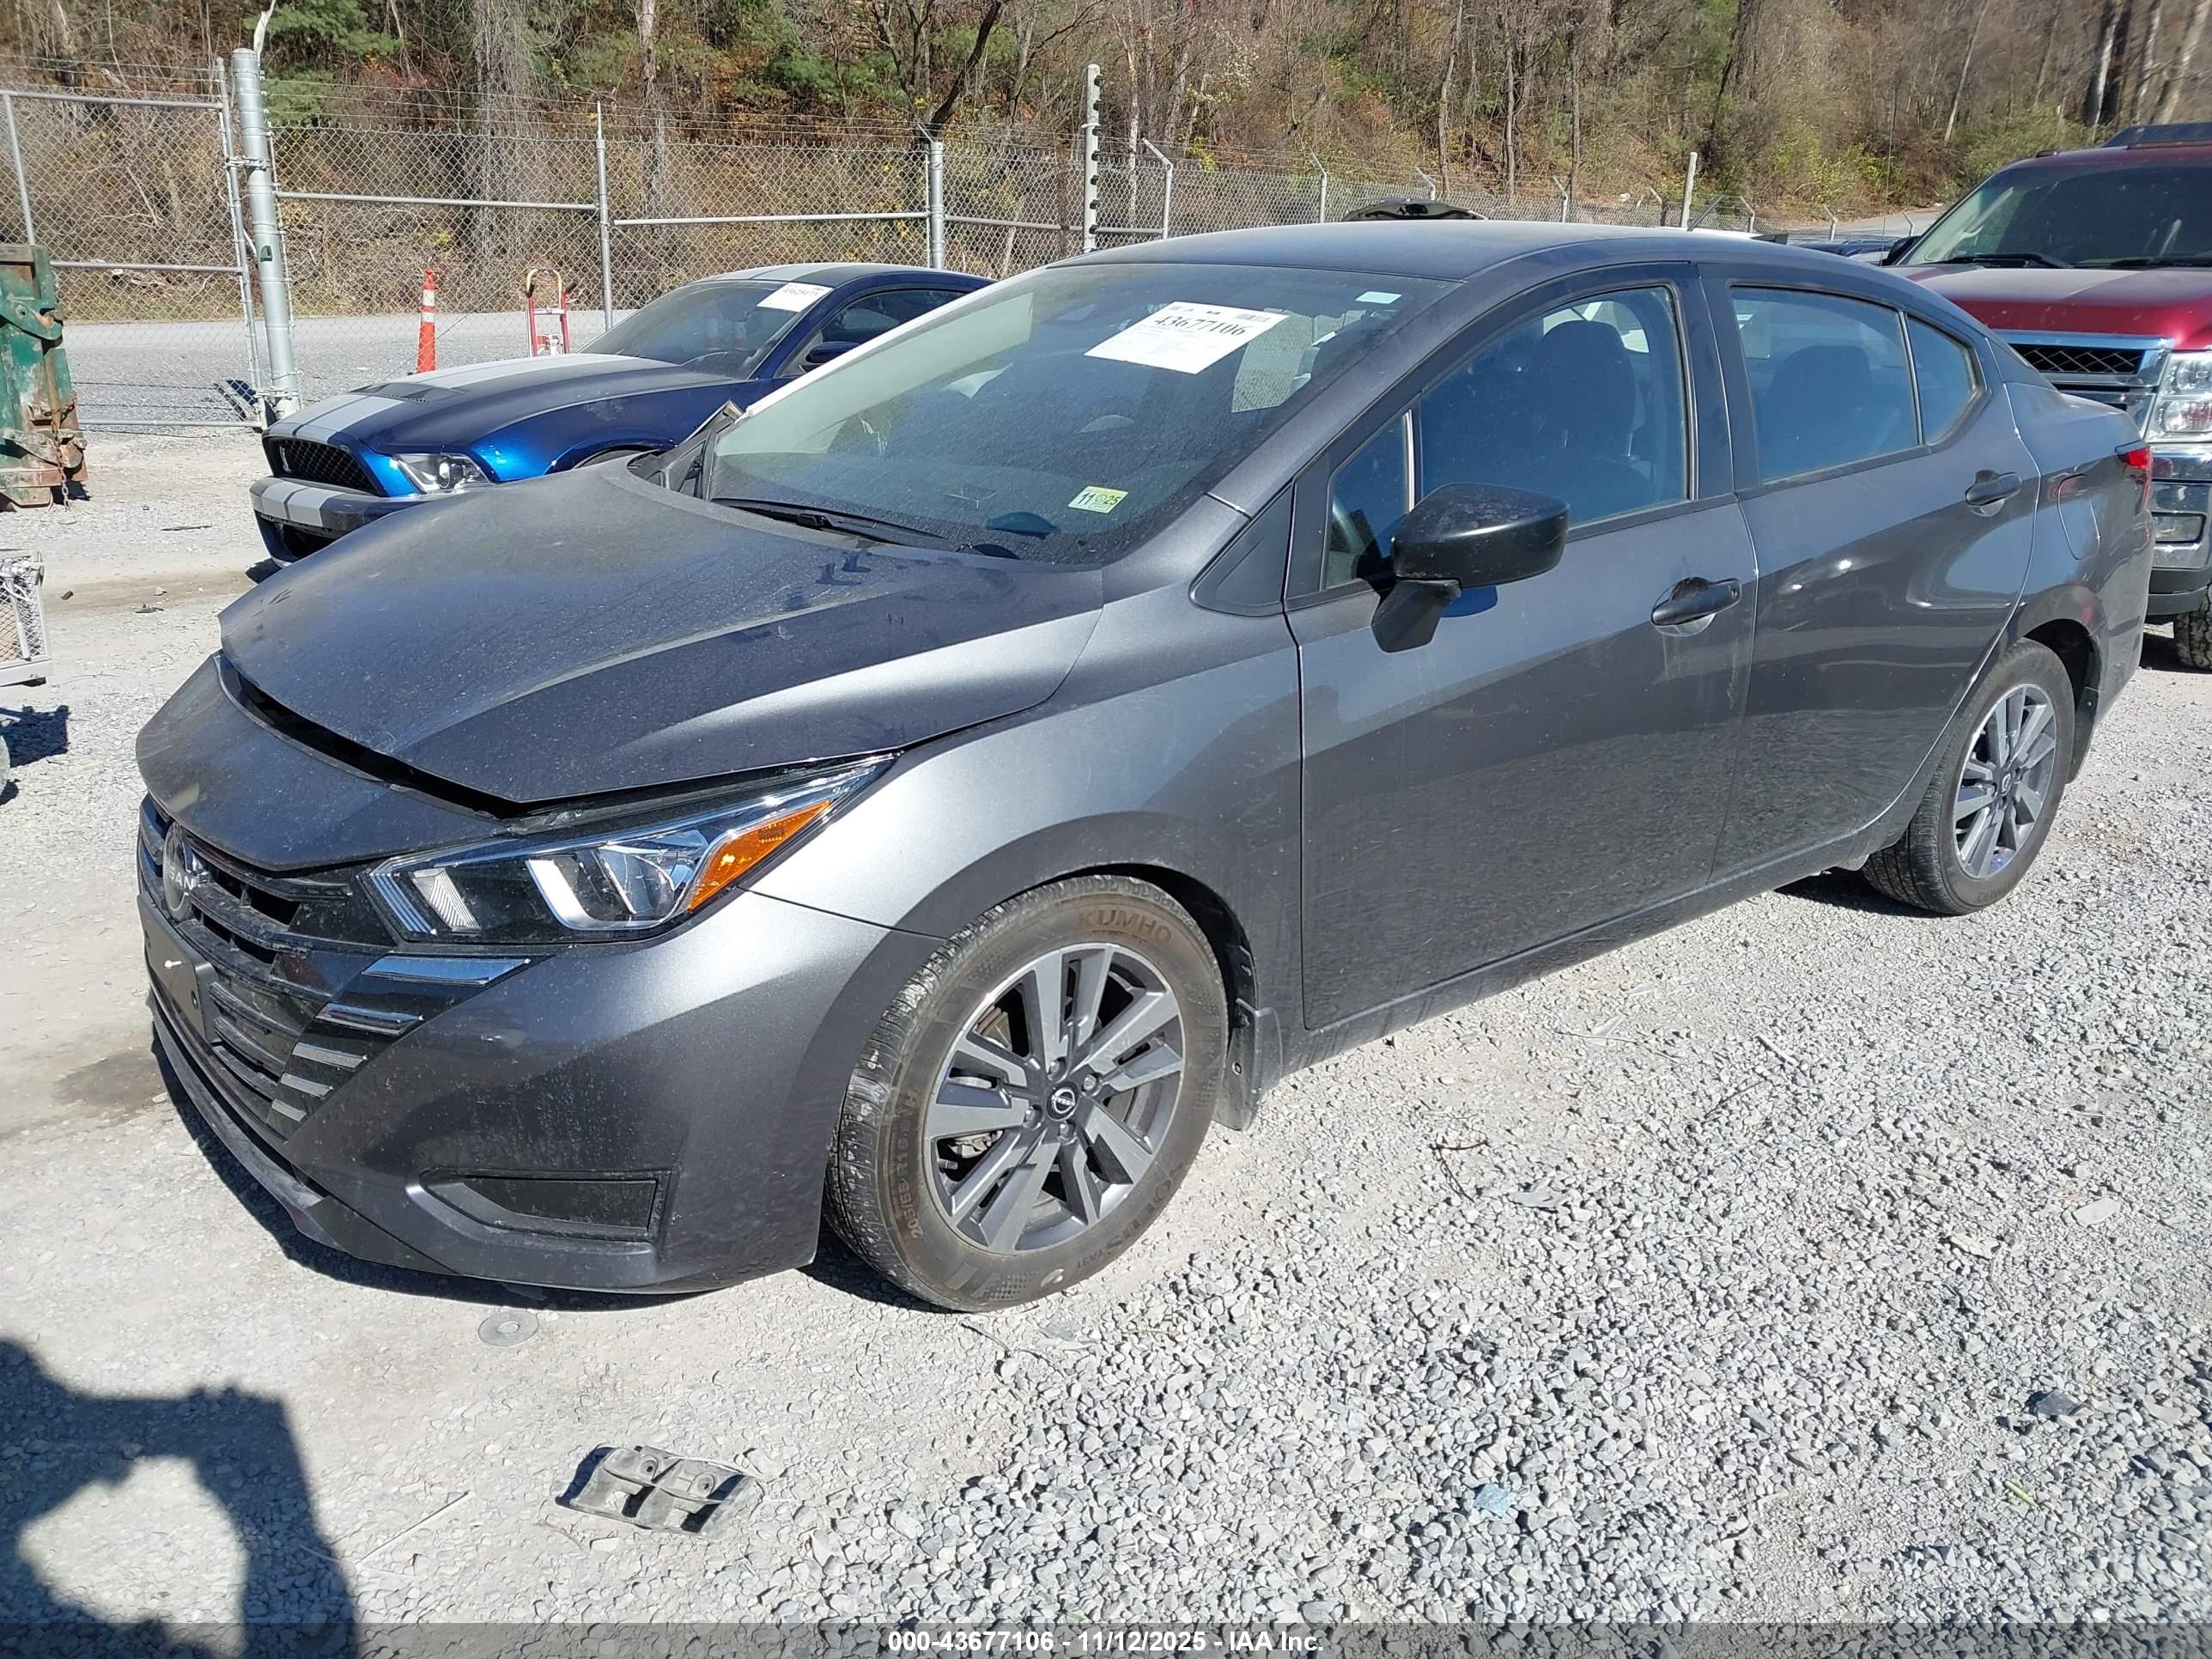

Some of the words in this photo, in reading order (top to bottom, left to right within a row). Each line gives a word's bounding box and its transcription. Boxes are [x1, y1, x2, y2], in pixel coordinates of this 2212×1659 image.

[1153, 314, 1252, 336] 43677106
[1077, 492, 1097, 505] 11
[1103, 495, 1121, 506] 25
[1079, 908, 1172, 942] KUMHO
[1105, 1161, 1185, 1255] SOLUS
